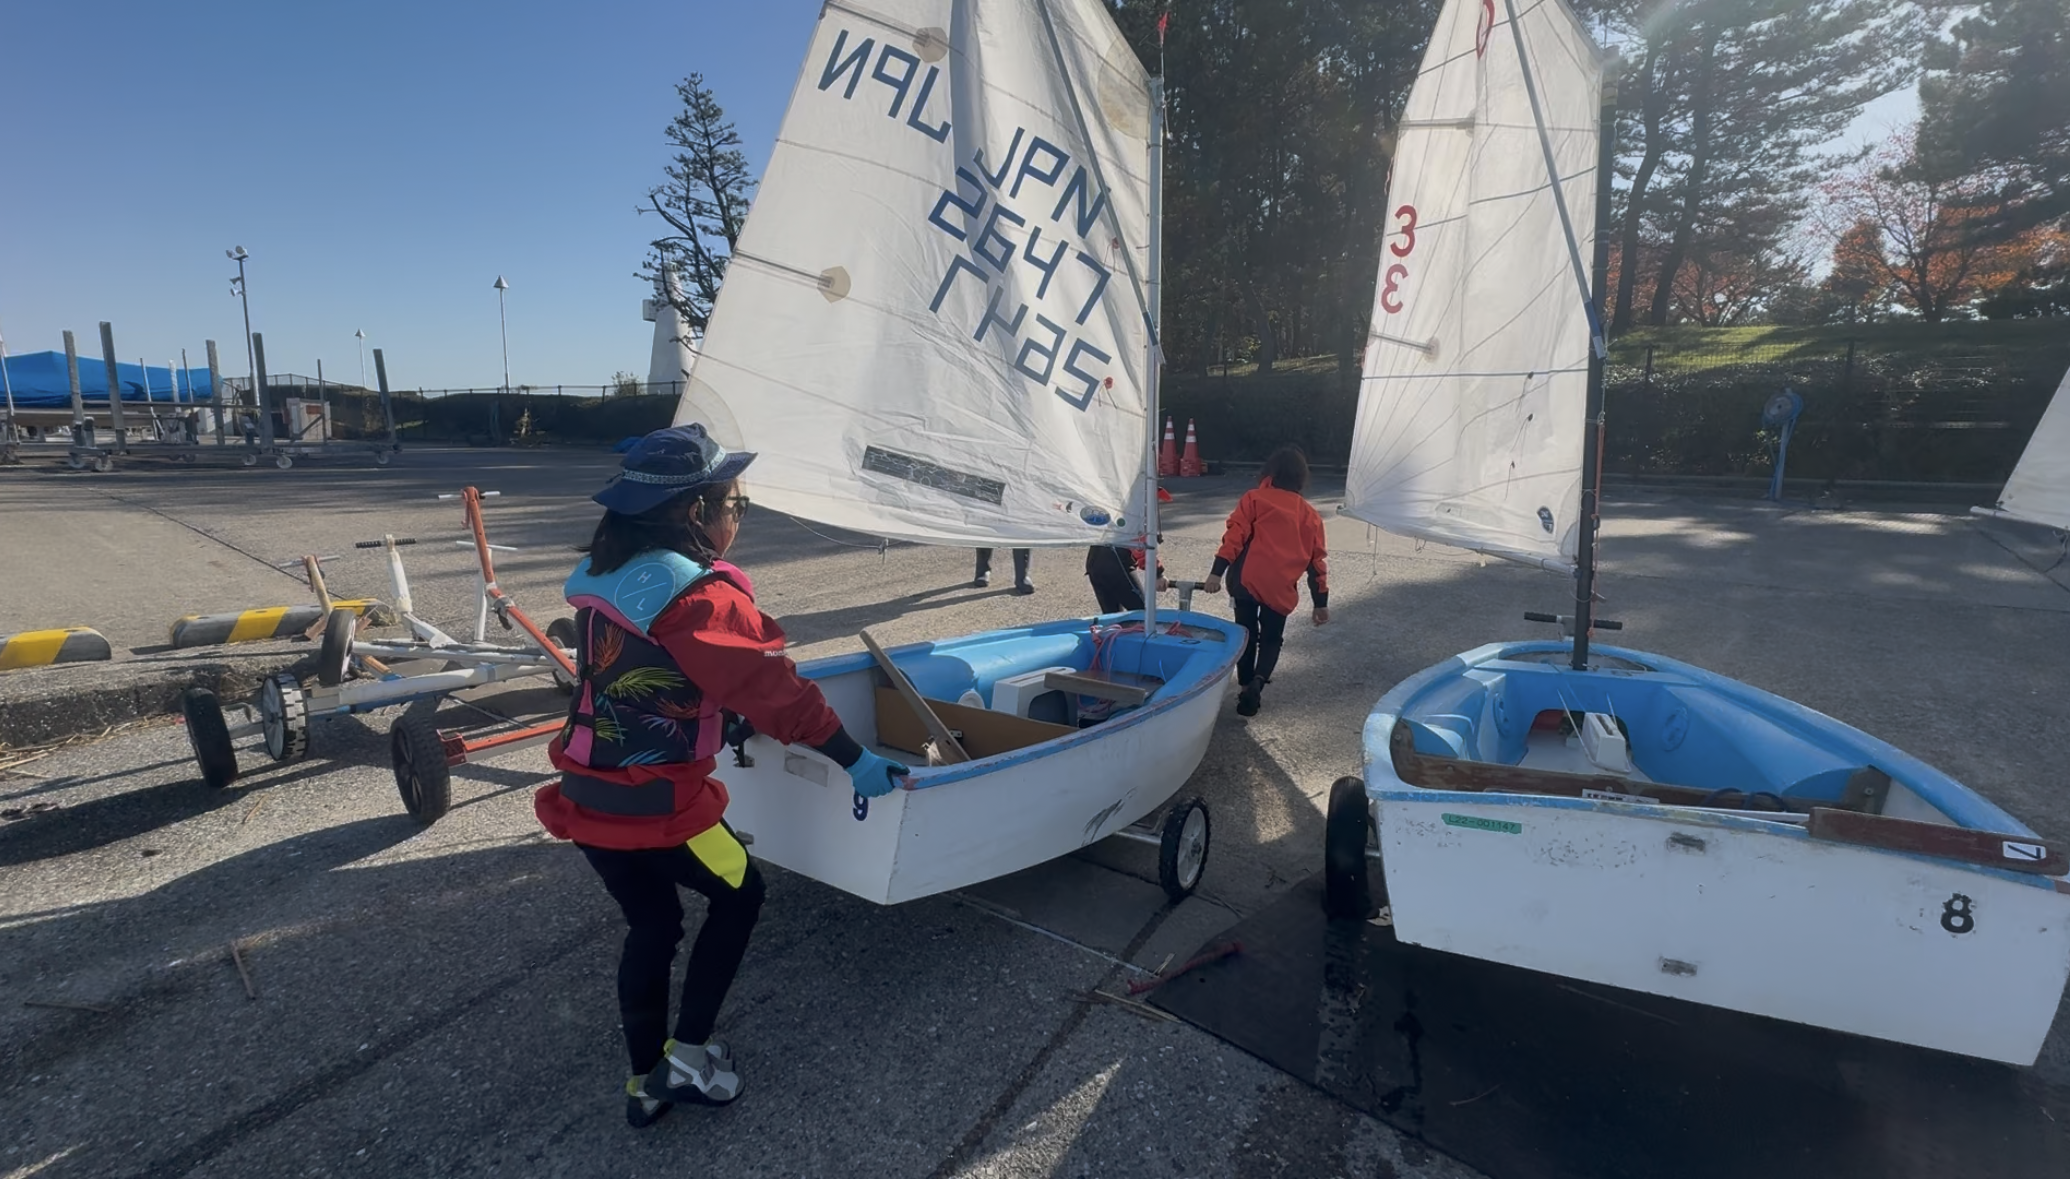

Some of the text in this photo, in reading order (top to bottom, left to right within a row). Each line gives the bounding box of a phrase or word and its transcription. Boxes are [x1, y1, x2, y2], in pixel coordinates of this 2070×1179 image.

[973, 127, 1106, 239] JPN
[927, 166, 1112, 326] 2647
[1390, 205, 1417, 257] 3
[637, 571, 652, 584] H
[636, 597, 645, 611] L
[853, 790, 868, 821] 9
[1941, 892, 1974, 934] 8
